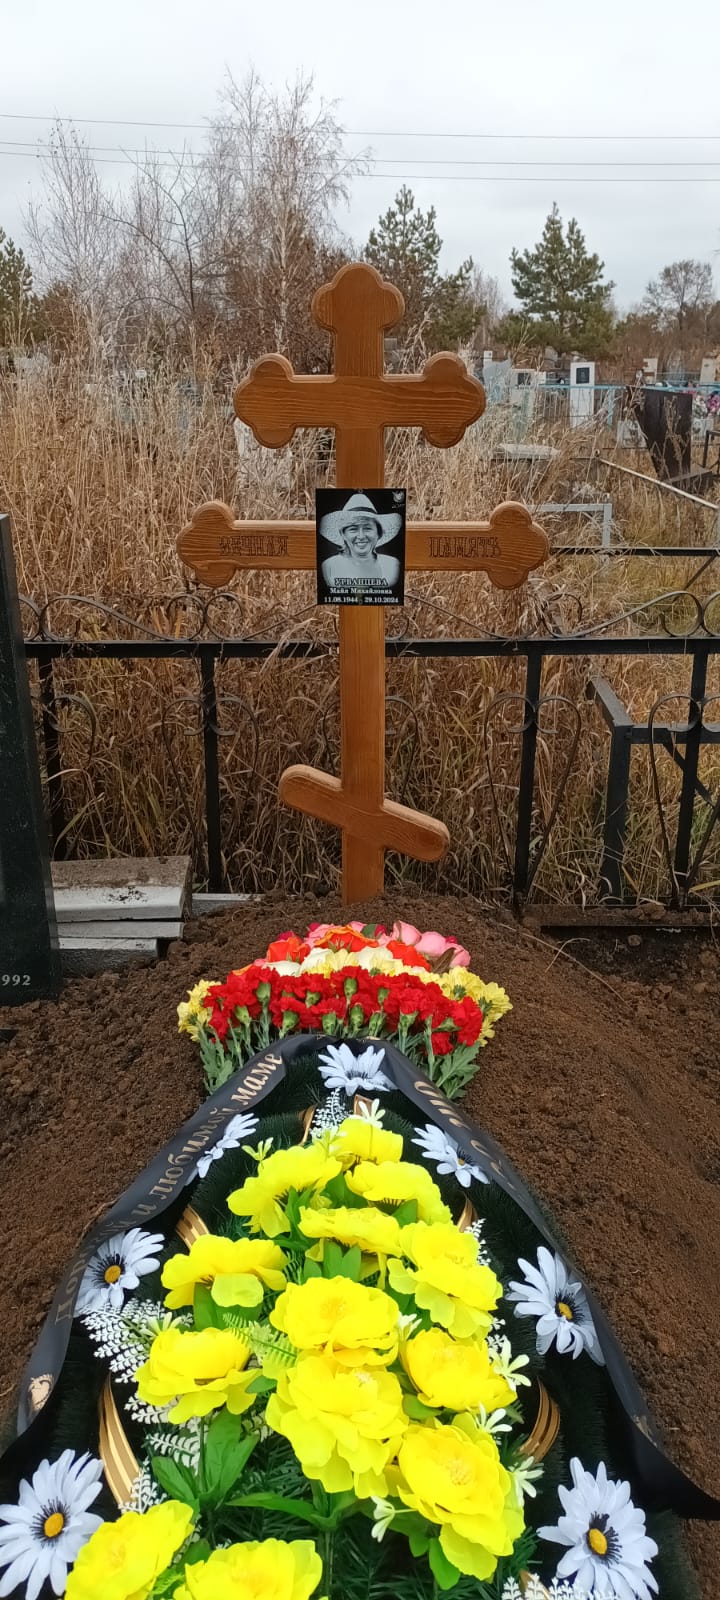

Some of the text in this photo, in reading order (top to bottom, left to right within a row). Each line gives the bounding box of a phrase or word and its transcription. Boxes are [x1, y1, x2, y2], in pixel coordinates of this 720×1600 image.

[131, 1203, 157, 1217] и
[153, 1107, 240, 1200] любимой
[231, 1052, 283, 1106] маме
